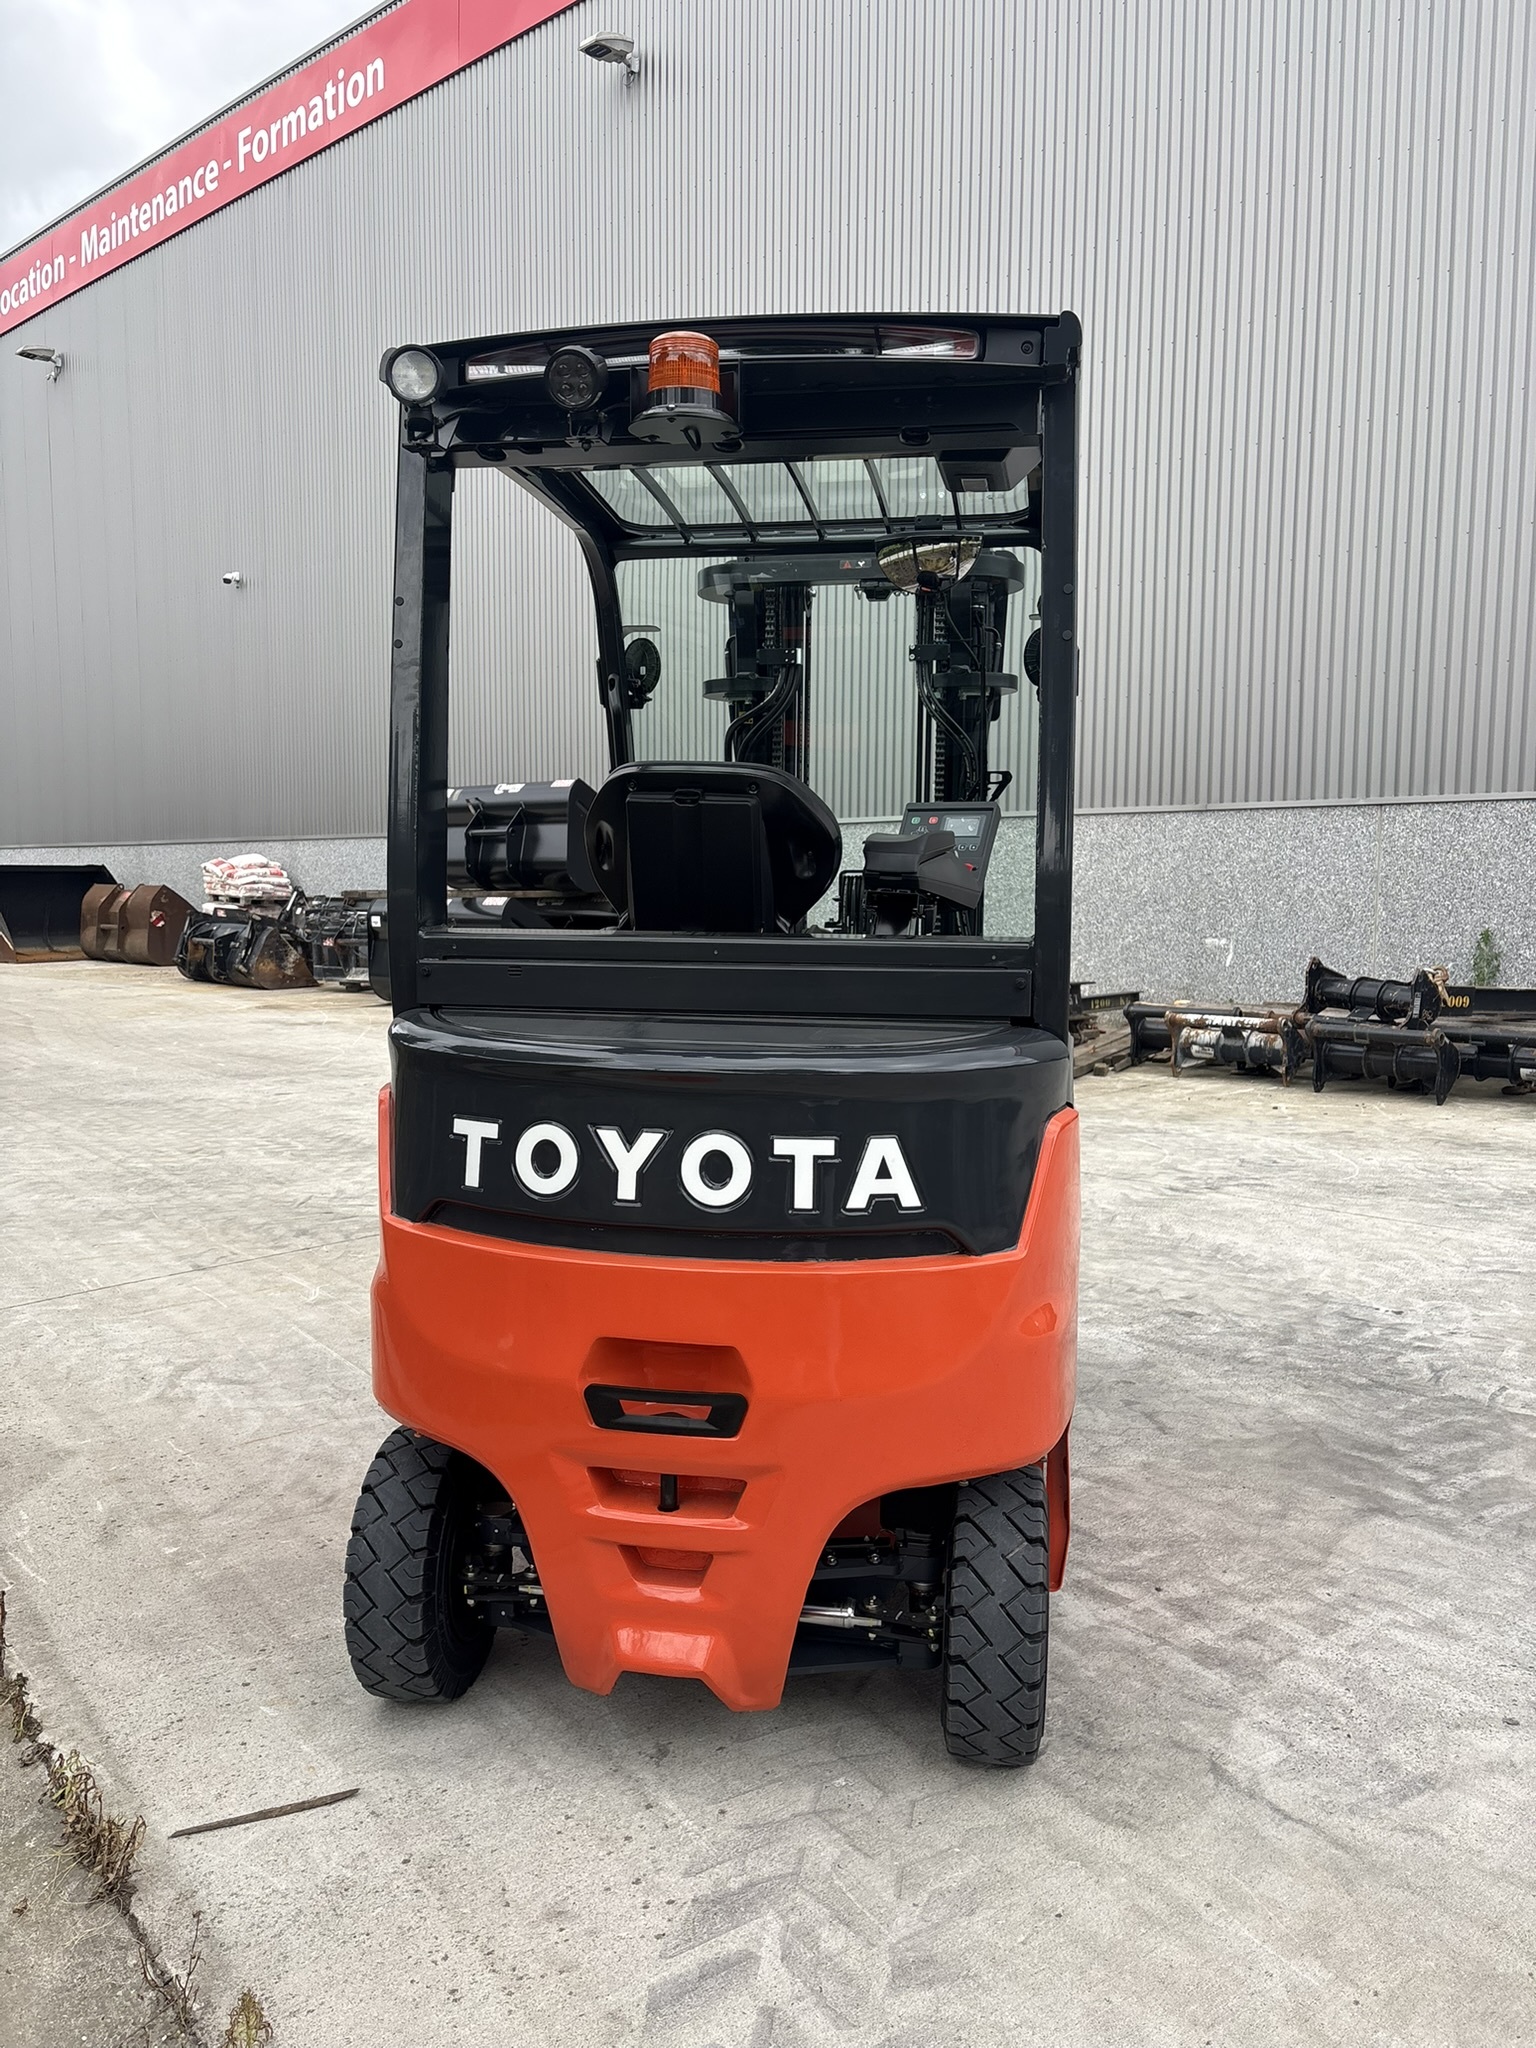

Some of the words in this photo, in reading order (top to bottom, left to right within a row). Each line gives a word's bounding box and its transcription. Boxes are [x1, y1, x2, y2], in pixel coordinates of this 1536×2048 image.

[0, 254, 65, 316] ocation
[81, 160, 219, 268] Maintenance
[238, 57, 385, 174] Formation
[451, 1116, 924, 1211] TOYOTA
